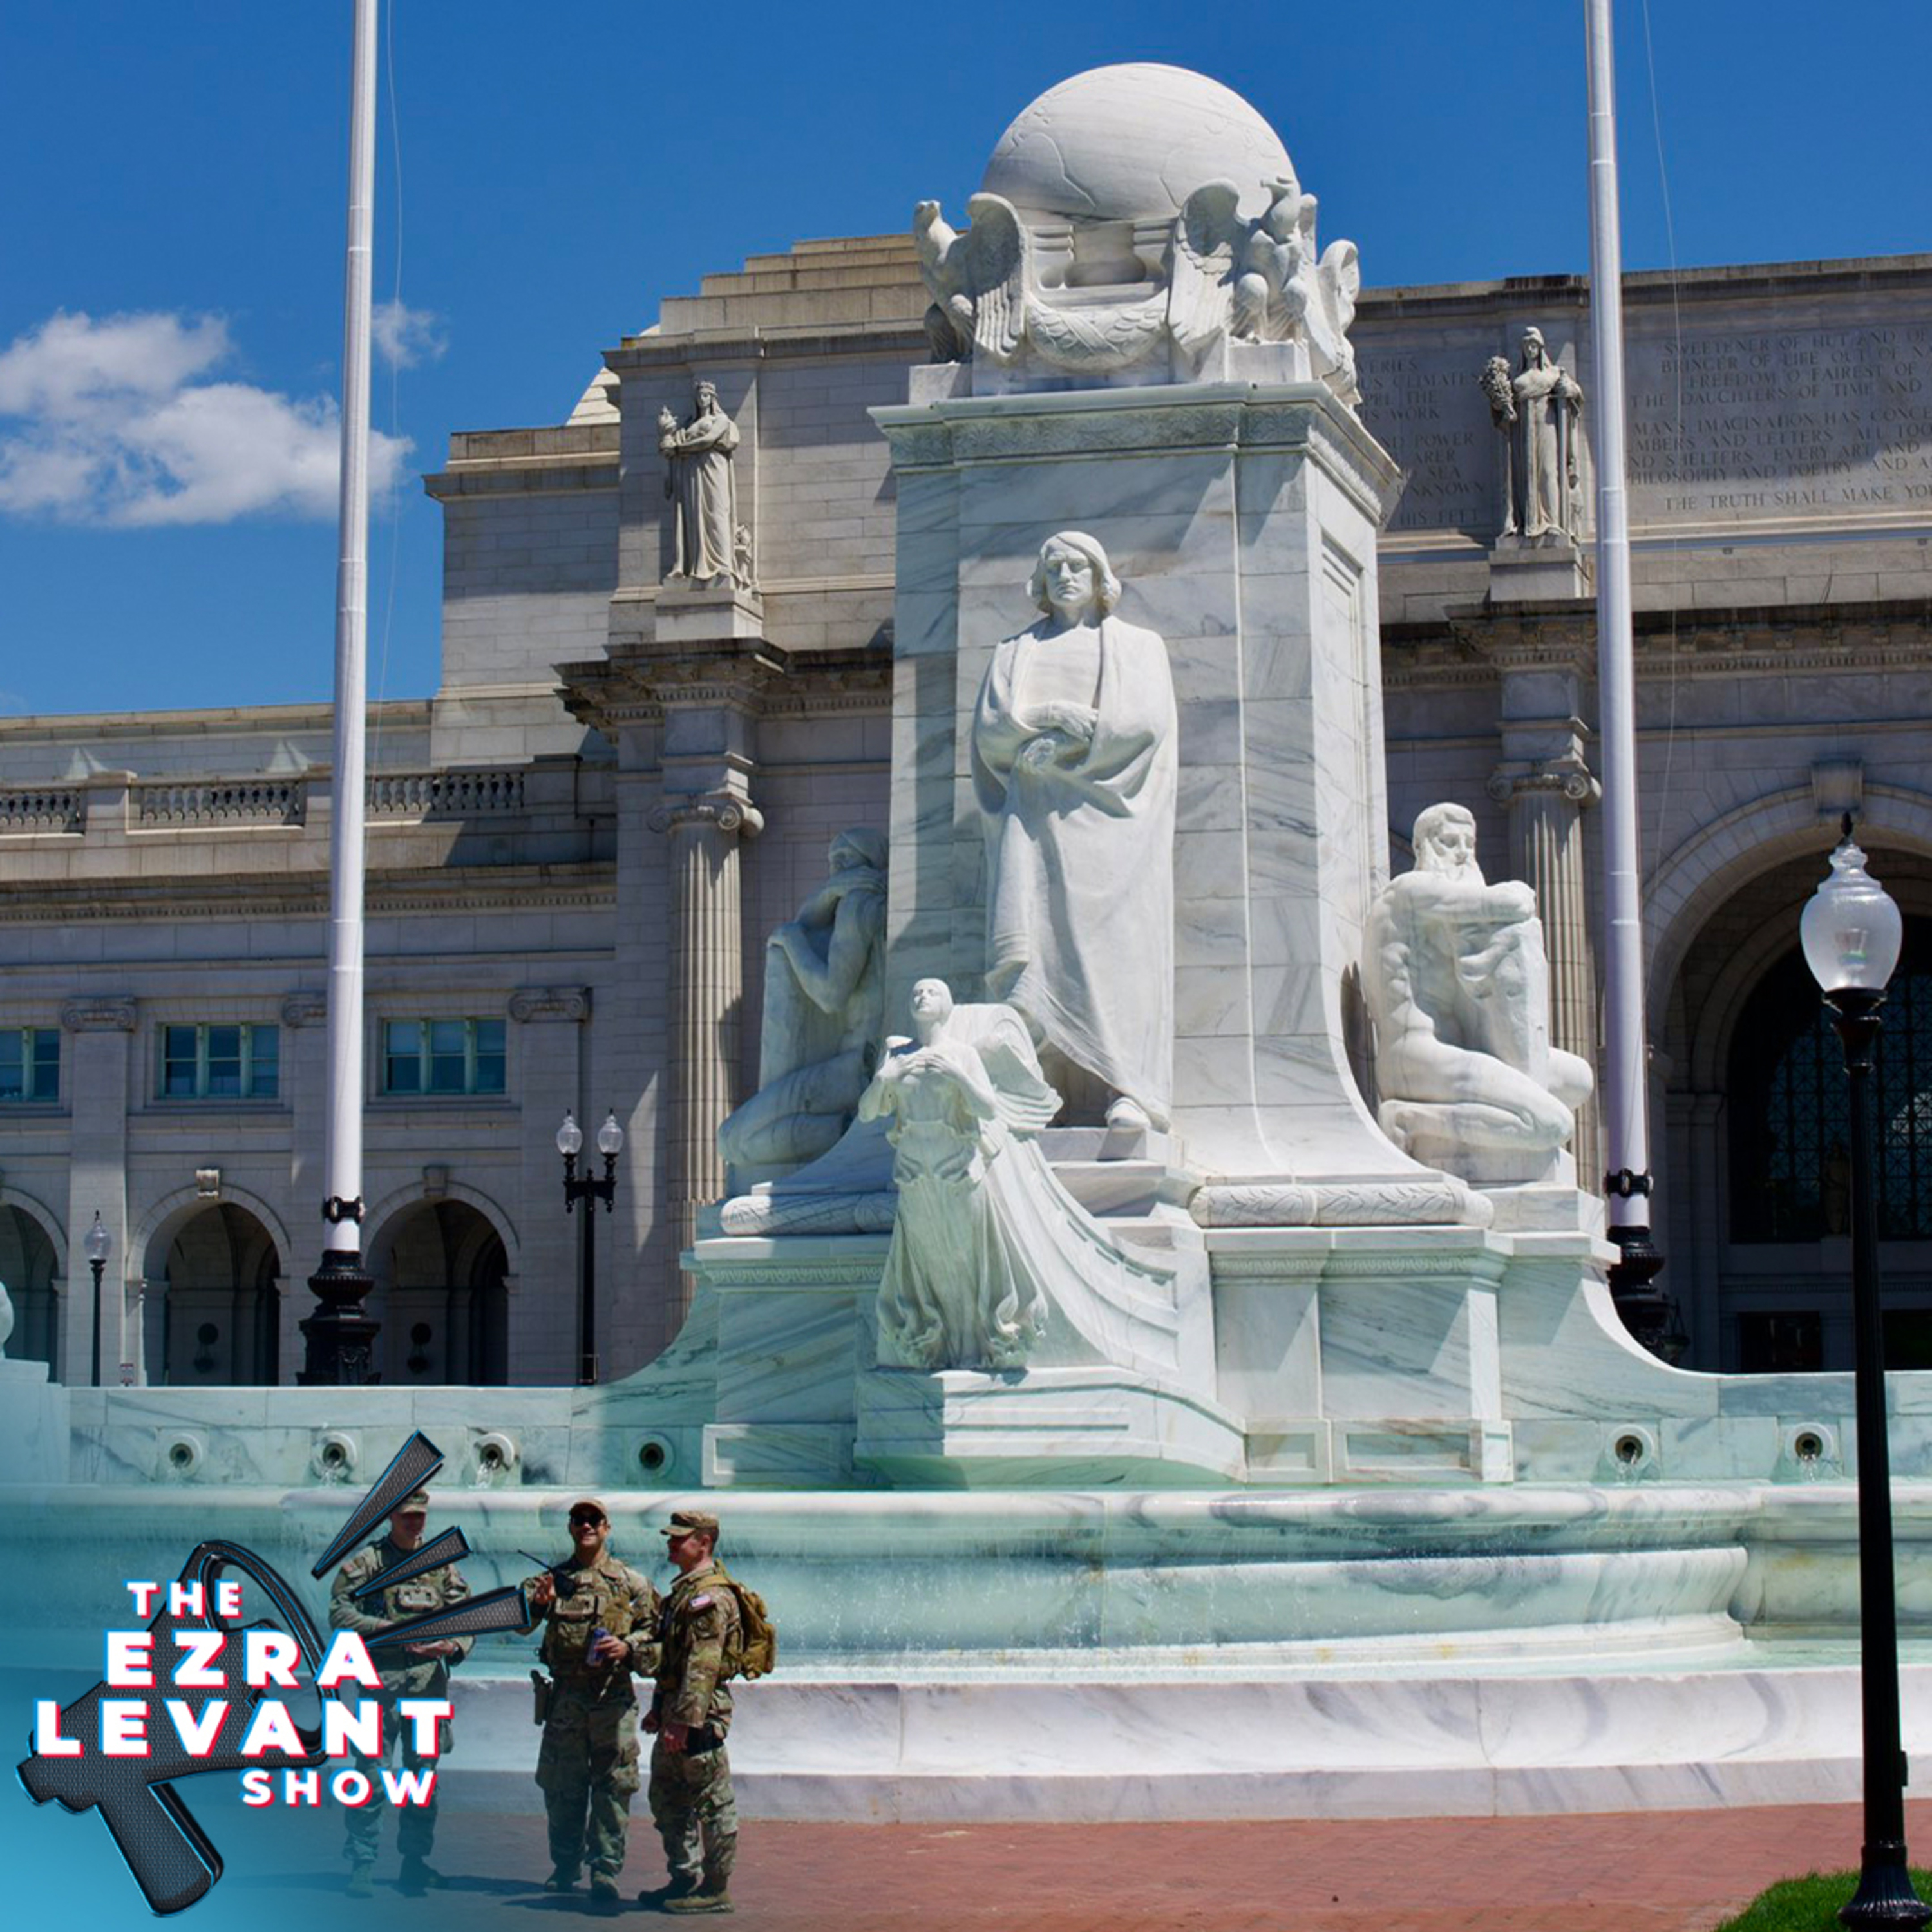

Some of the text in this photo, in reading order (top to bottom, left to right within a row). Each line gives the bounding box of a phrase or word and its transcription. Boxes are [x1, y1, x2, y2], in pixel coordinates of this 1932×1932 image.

[1664, 328, 1927, 355] SWEETENER OF HUT AND OF
[1750, 354, 1772, 369] OF
[1783, 352, 1819, 366] LIFE
[1832, 348, 1865, 363] OUT
[1878, 346, 1900, 361] OF
[1689, 372, 1776, 388] FREEDOM
[1812, 365, 1883, 382] FAIREST
[1895, 361, 1917, 376] OF
[1407, 388, 1437, 405] THE
[1630, 392, 1667, 408] THE
[1799, 383, 1821, 399] OF
[1832, 382, 1871, 397] TIME
[1886, 377, 1922, 394] AND
[1390, 406, 1441, 421] WORK
[1824, 408, 1861, 424] HAS
[1380, 432, 1474, 449] ND POWER
[1634, 436, 1696, 452] MBERS
[1711, 433, 1747, 448] AND
[1756, 428, 1834, 446] LETTERS
[1857, 426, 1884, 440] ALL
[1629, 439, 1920, 469] ND SHELTERS EVERY ART AND
[1428, 465, 1461, 480] SEA
[1739, 464, 1777, 479] AND
[1788, 460, 1852, 477] POETRY
[1871, 457, 1908, 473] AND
[1664, 495, 1698, 511] THE
[1705, 491, 1765, 509] TRUTH
[1774, 488, 1830, 506] SHALL
[1841, 485, 1895, 502] MAKE
[1438, 508, 1478, 524] FEET
